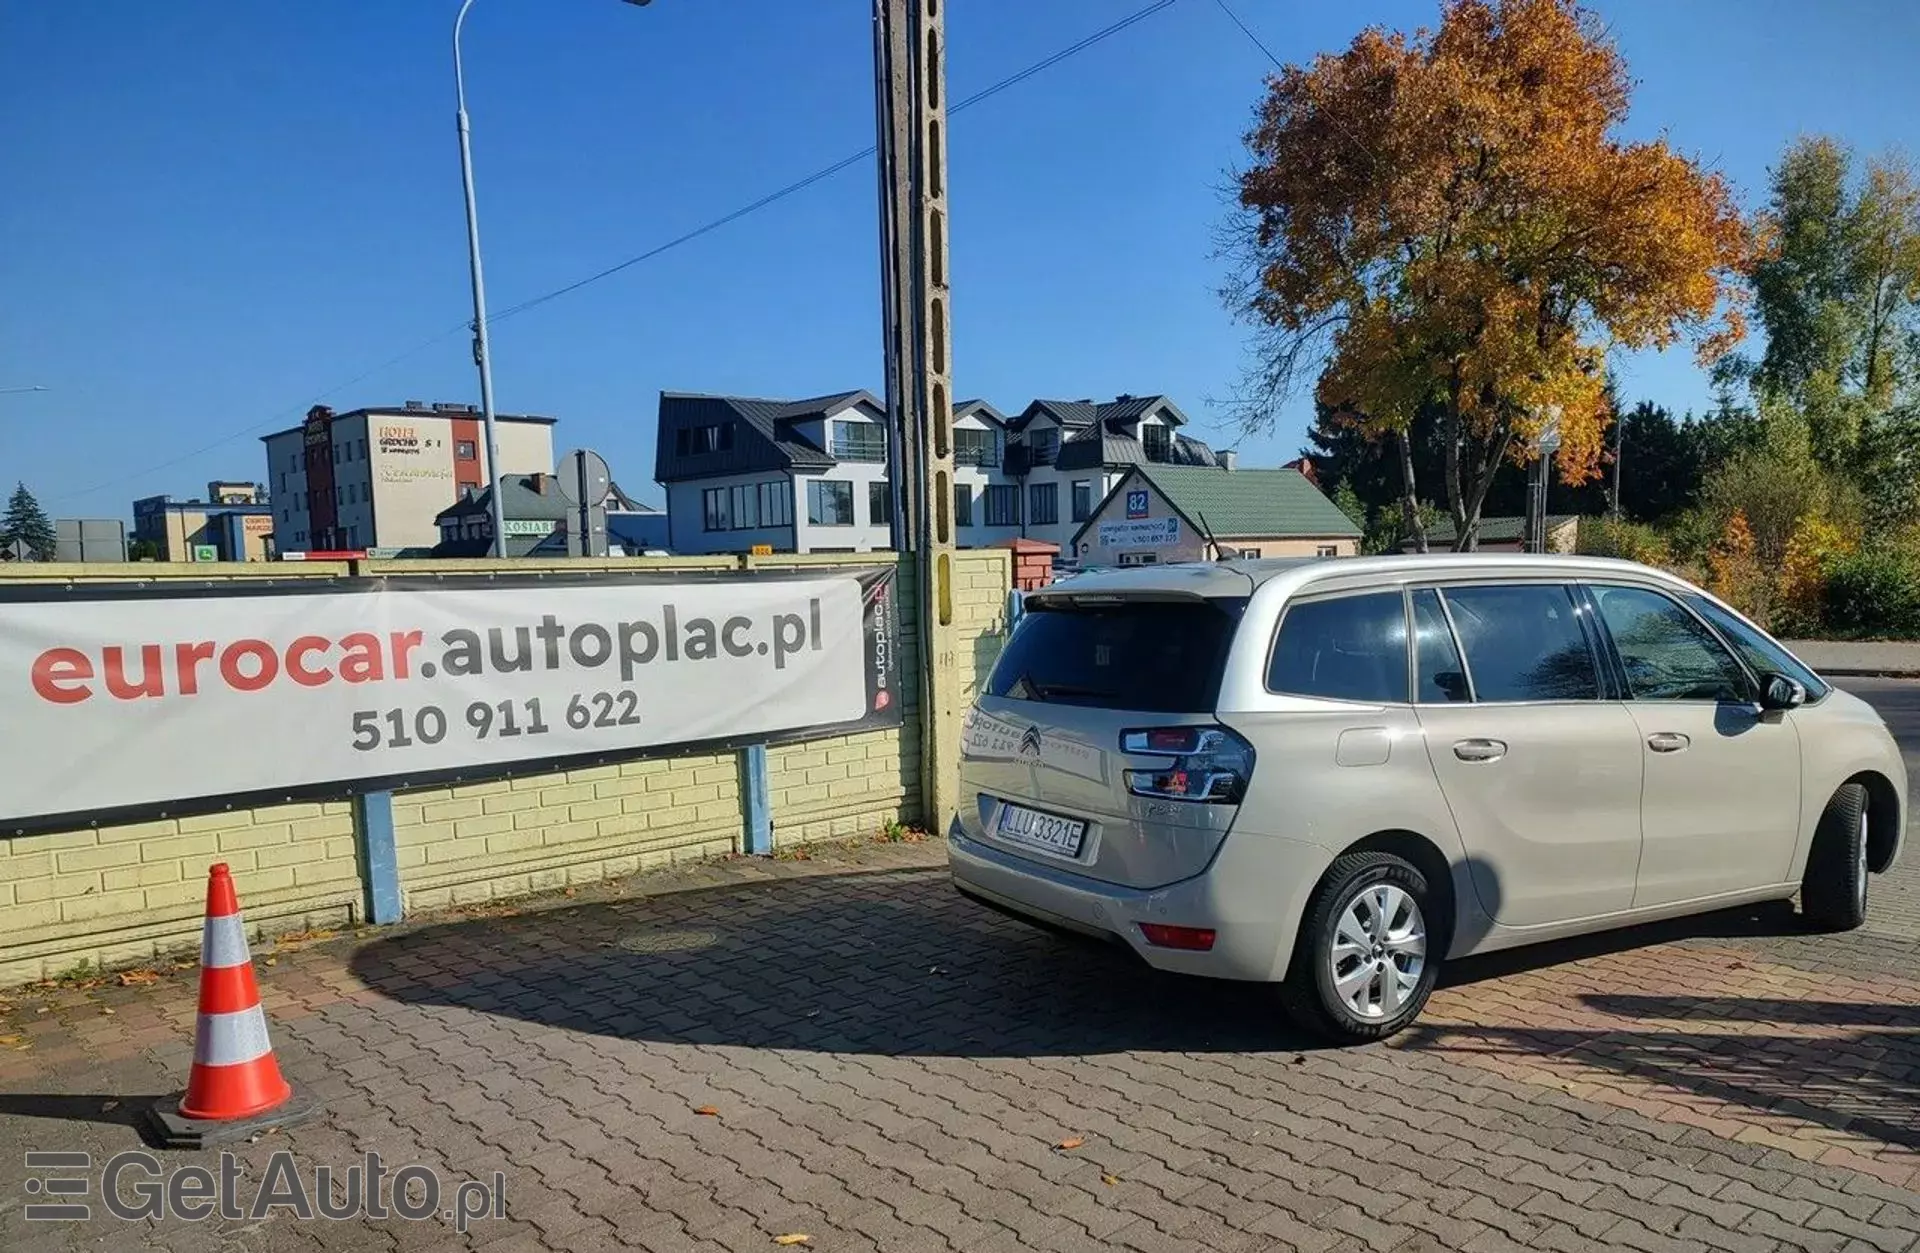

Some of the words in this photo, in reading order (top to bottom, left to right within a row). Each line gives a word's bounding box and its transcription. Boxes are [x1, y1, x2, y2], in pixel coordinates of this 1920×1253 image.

[1129, 493, 1146, 511] 82
[31, 598, 822, 705] eurocar.autoplac.pl
[352, 706, 447, 751] 510
[466, 697, 549, 740] 911
[565, 691, 641, 730] 622
[1035, 815, 1082, 849] 3321E
